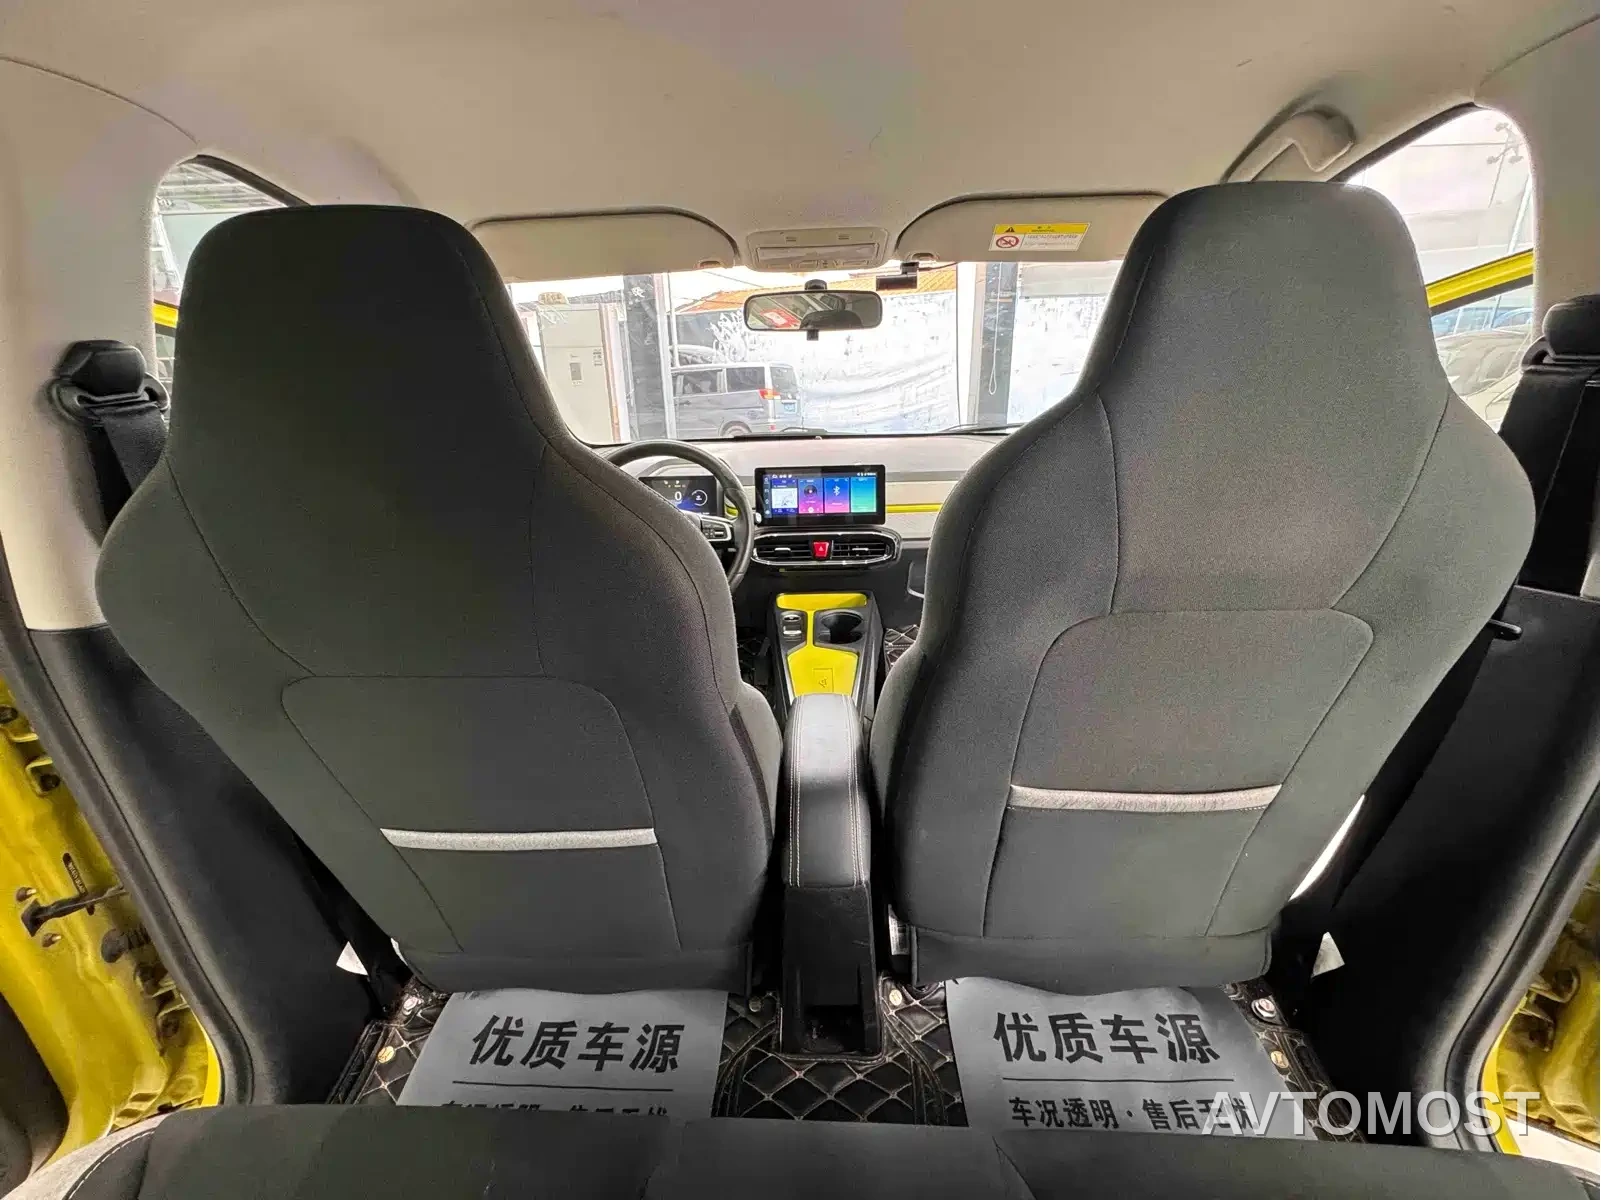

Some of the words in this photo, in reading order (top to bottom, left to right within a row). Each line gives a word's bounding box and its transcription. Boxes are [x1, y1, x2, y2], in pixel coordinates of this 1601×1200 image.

[674, 491, 682, 501] 0
[469, 1014, 686, 1074] 优质车源
[993, 1012, 1221, 1064] 优质车源
